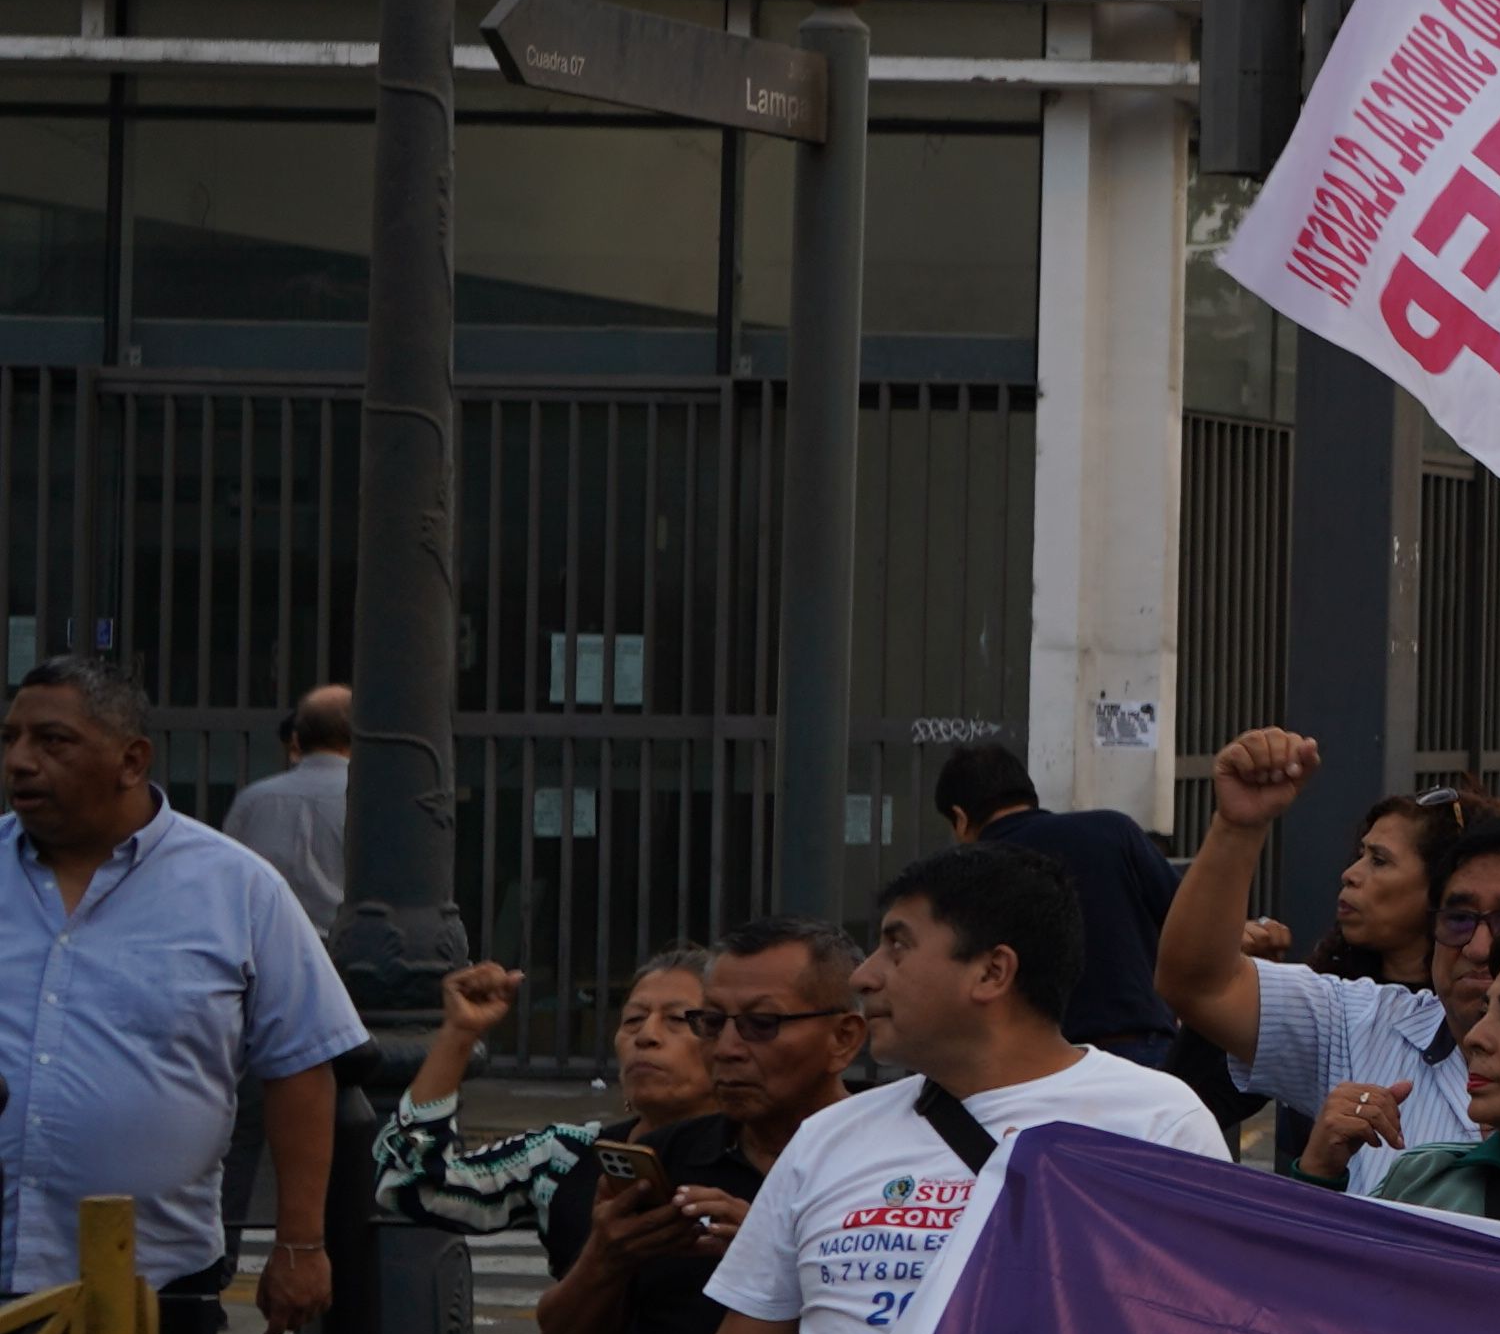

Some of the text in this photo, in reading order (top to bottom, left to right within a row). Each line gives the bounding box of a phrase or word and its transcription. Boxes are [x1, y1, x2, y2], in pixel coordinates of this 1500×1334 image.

[526, 46, 585, 76] Cuadra 07
[745, 77, 811, 129] Lampa
[846, 1211, 876, 1227] IV
[818, 1232, 917, 1257] NACIONAL
[842, 1263, 852, 1281] 7
[858, 1263, 870, 1281] Y
[874, 1262, 887, 1280] 8
[894, 1261, 925, 1279] DE
